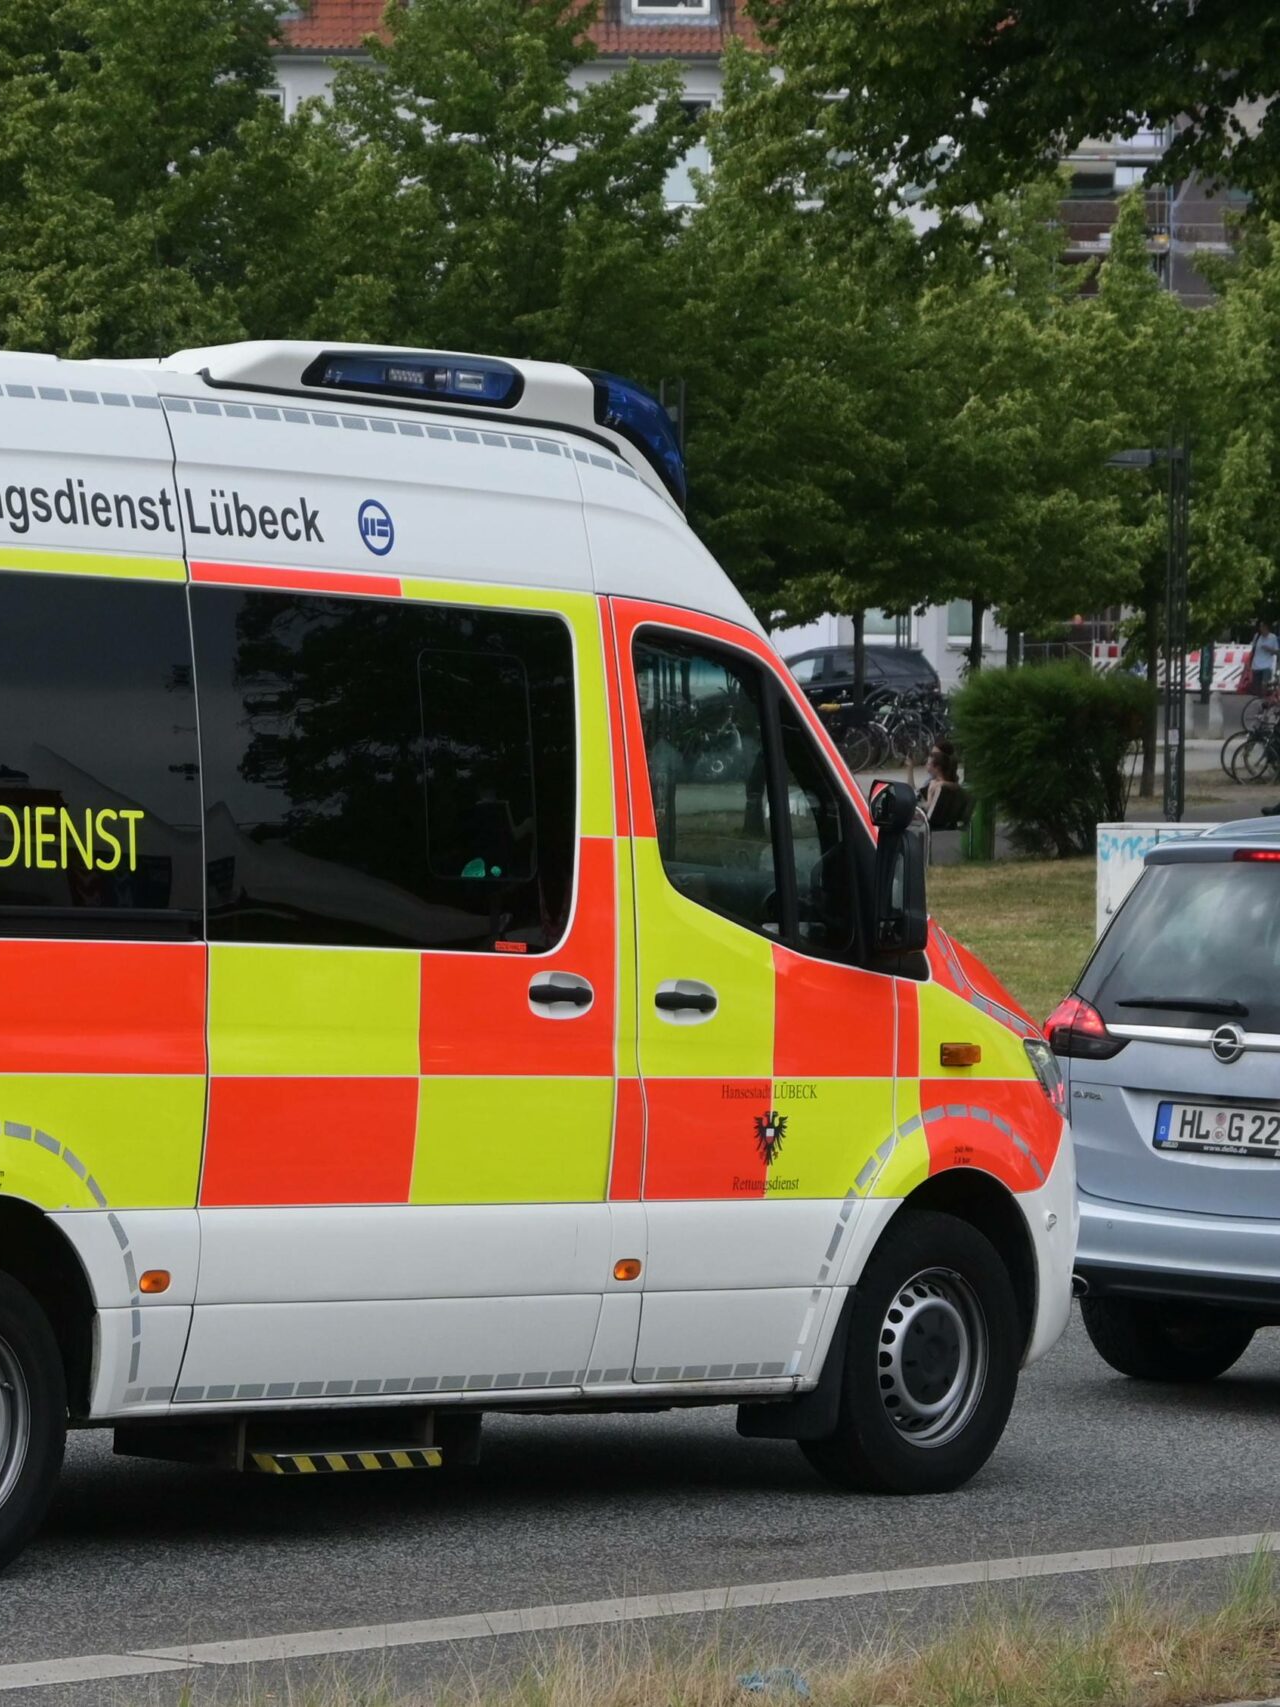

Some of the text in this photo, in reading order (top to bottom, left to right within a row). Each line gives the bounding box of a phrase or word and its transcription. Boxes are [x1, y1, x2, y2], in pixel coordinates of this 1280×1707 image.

[184, 487, 325, 543] Lübeck
[774, 1081, 817, 1099] LÜBECK
[1179, 1109, 1210, 1139] HL
[1228, 1113, 1244, 1142] G
[732, 1176, 799, 1194] Rettungsdienst
